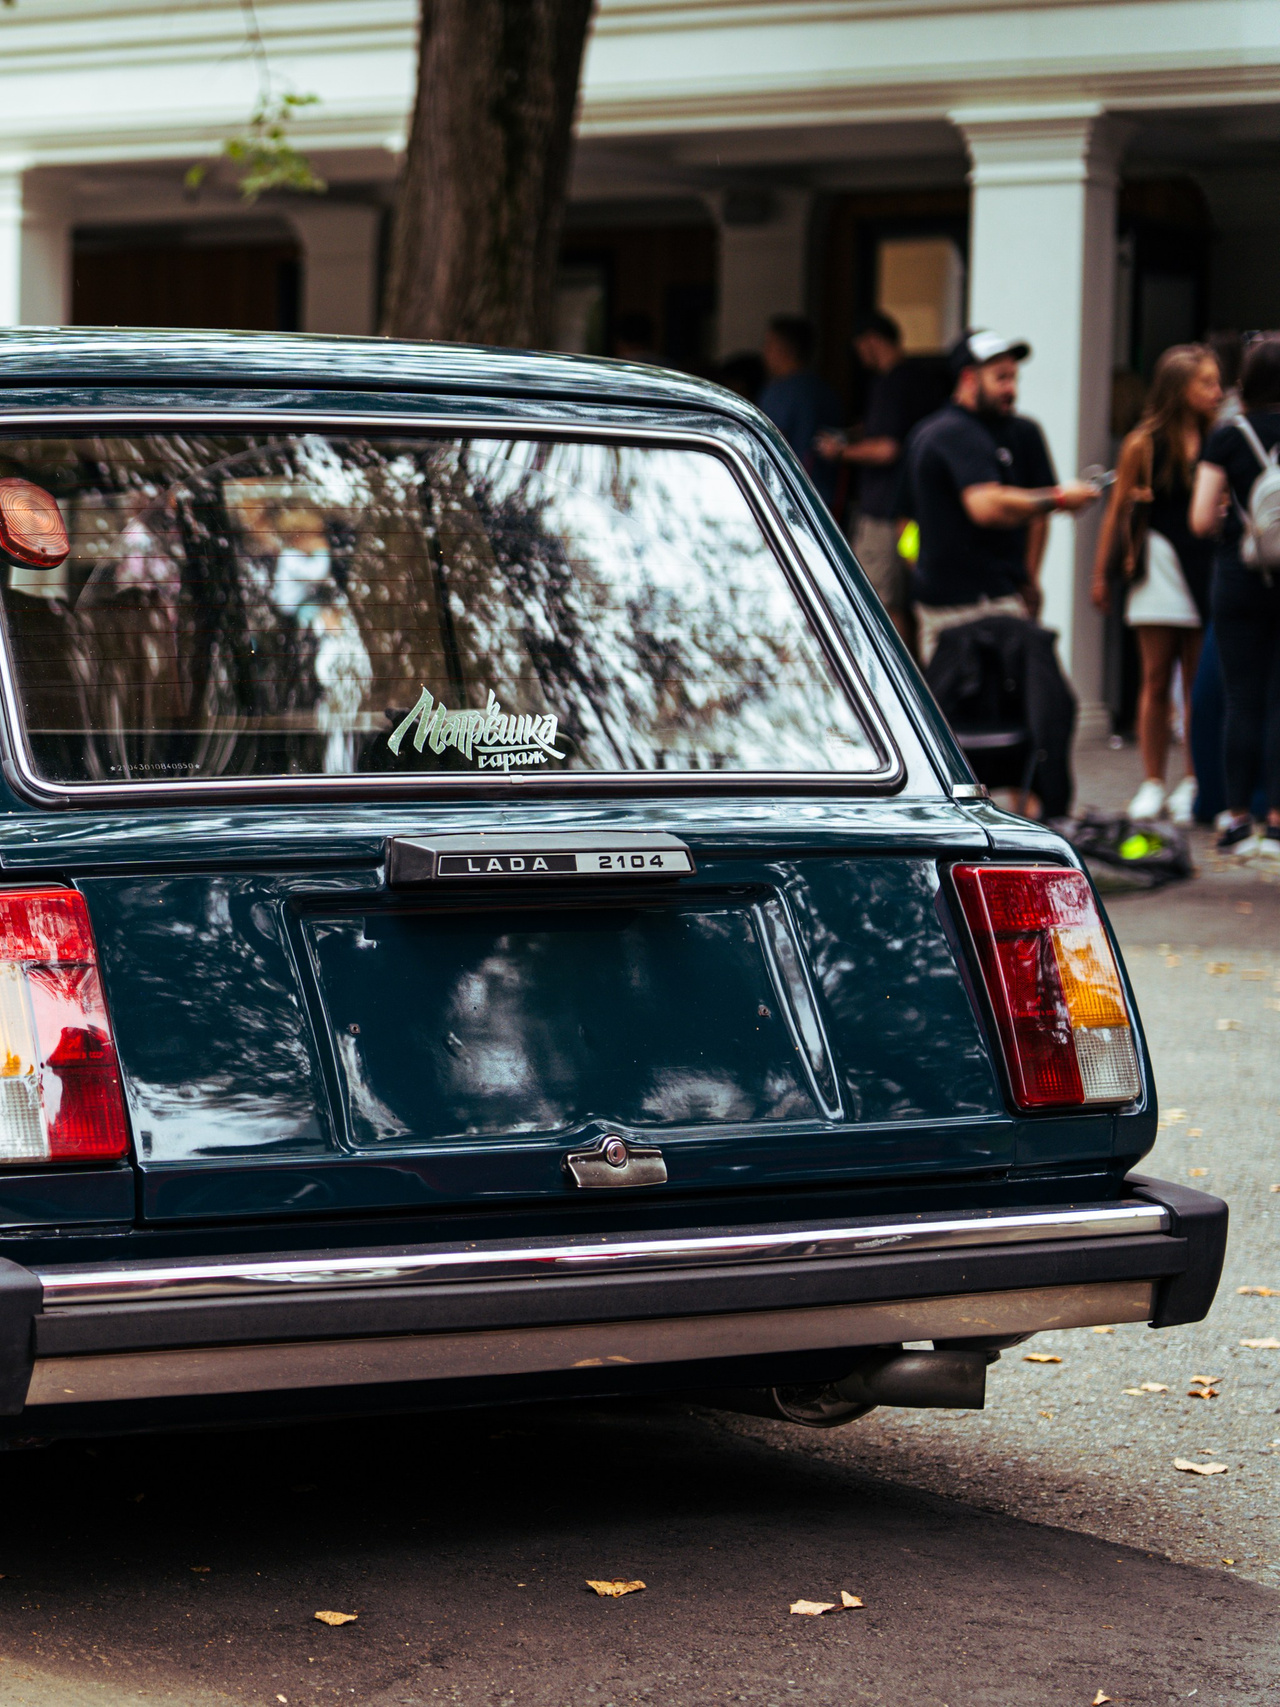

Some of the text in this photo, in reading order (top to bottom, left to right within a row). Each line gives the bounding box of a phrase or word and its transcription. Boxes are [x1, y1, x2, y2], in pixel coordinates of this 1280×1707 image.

[477, 751, 549, 772] гараж
[467, 854, 664, 872] LADA 2104
